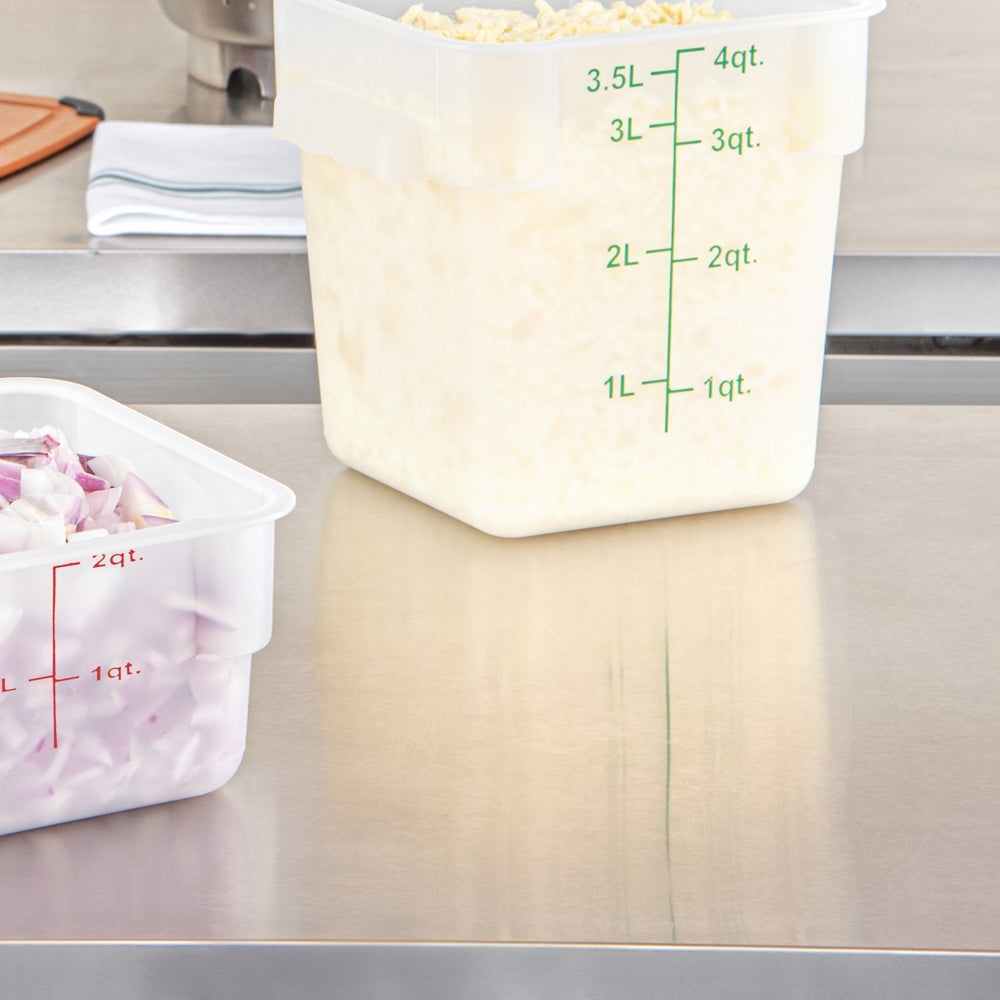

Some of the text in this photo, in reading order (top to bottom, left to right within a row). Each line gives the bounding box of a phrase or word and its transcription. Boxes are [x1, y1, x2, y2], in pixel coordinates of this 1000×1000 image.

[712, 44, 764, 74] 4qt.
[586, 64, 644, 94] 3.5L
[609, 116, 642, 143] 3L
[710, 126, 761, 155] 3qt.
[606, 243, 638, 269] 2L
[707, 243, 757, 271] 2qt.
[603, 373, 635, 399] 1L
[703, 374, 752, 401] 1qt.
[91, 549, 144, 569] 2qt.
[91, 661, 141, 681] 1qt.
